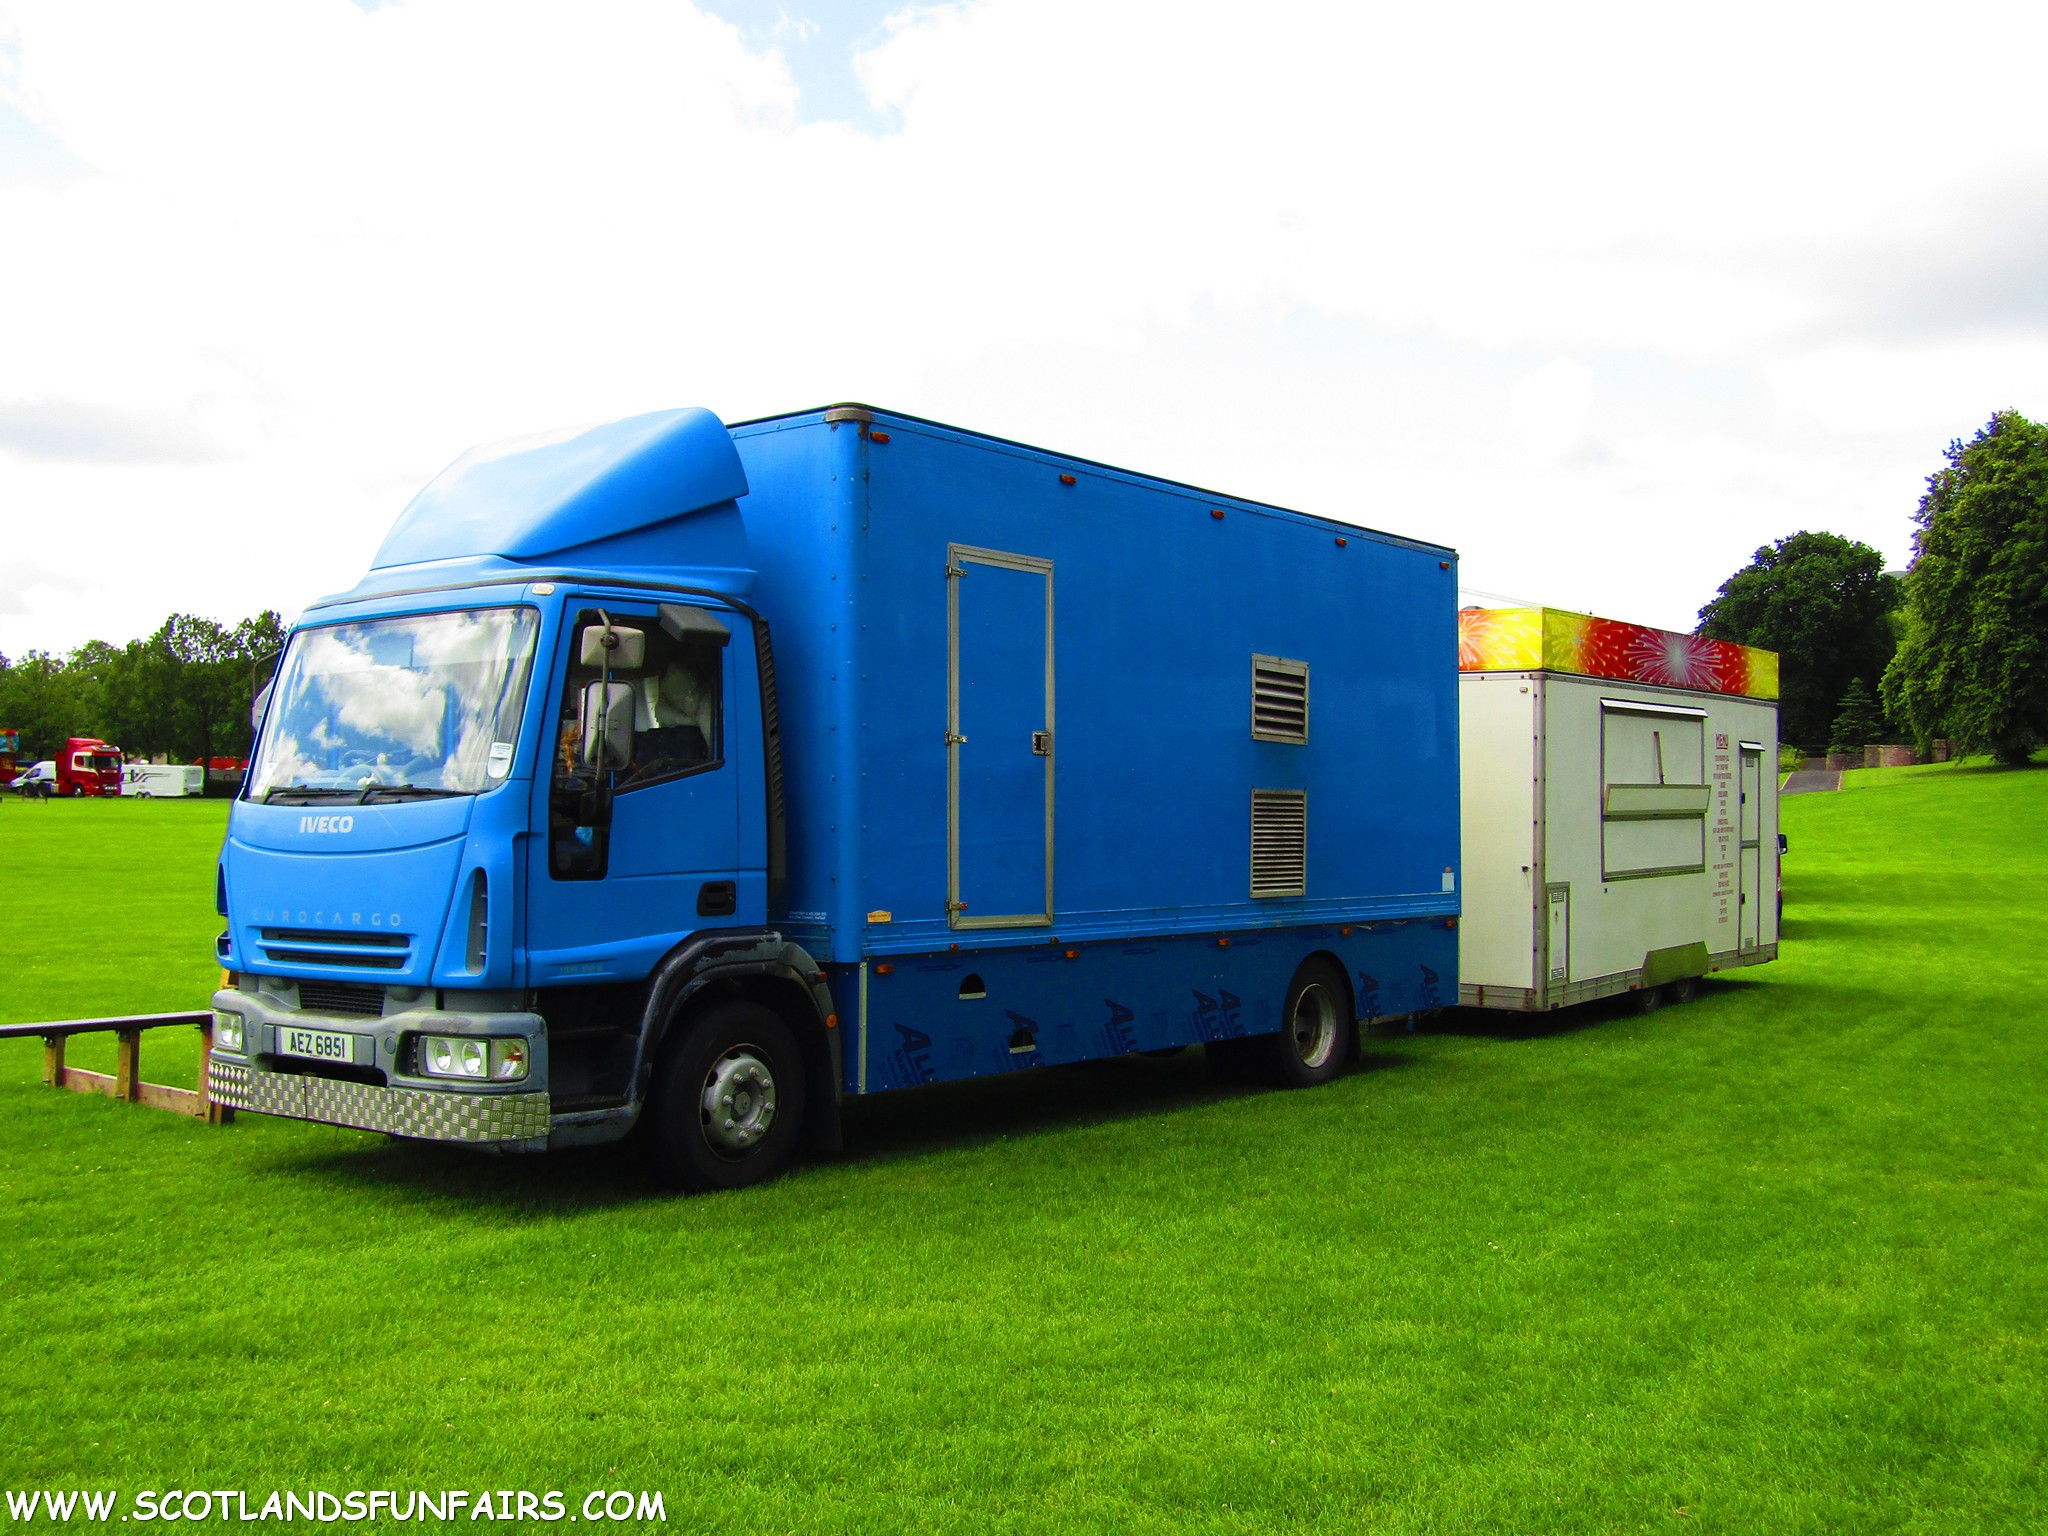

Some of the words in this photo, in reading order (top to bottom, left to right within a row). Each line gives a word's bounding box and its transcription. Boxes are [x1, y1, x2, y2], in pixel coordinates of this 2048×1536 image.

[299, 815, 354, 834] IVECO
[290, 1032, 313, 1054] AEZ
[315, 1035, 345, 1058] 6851
